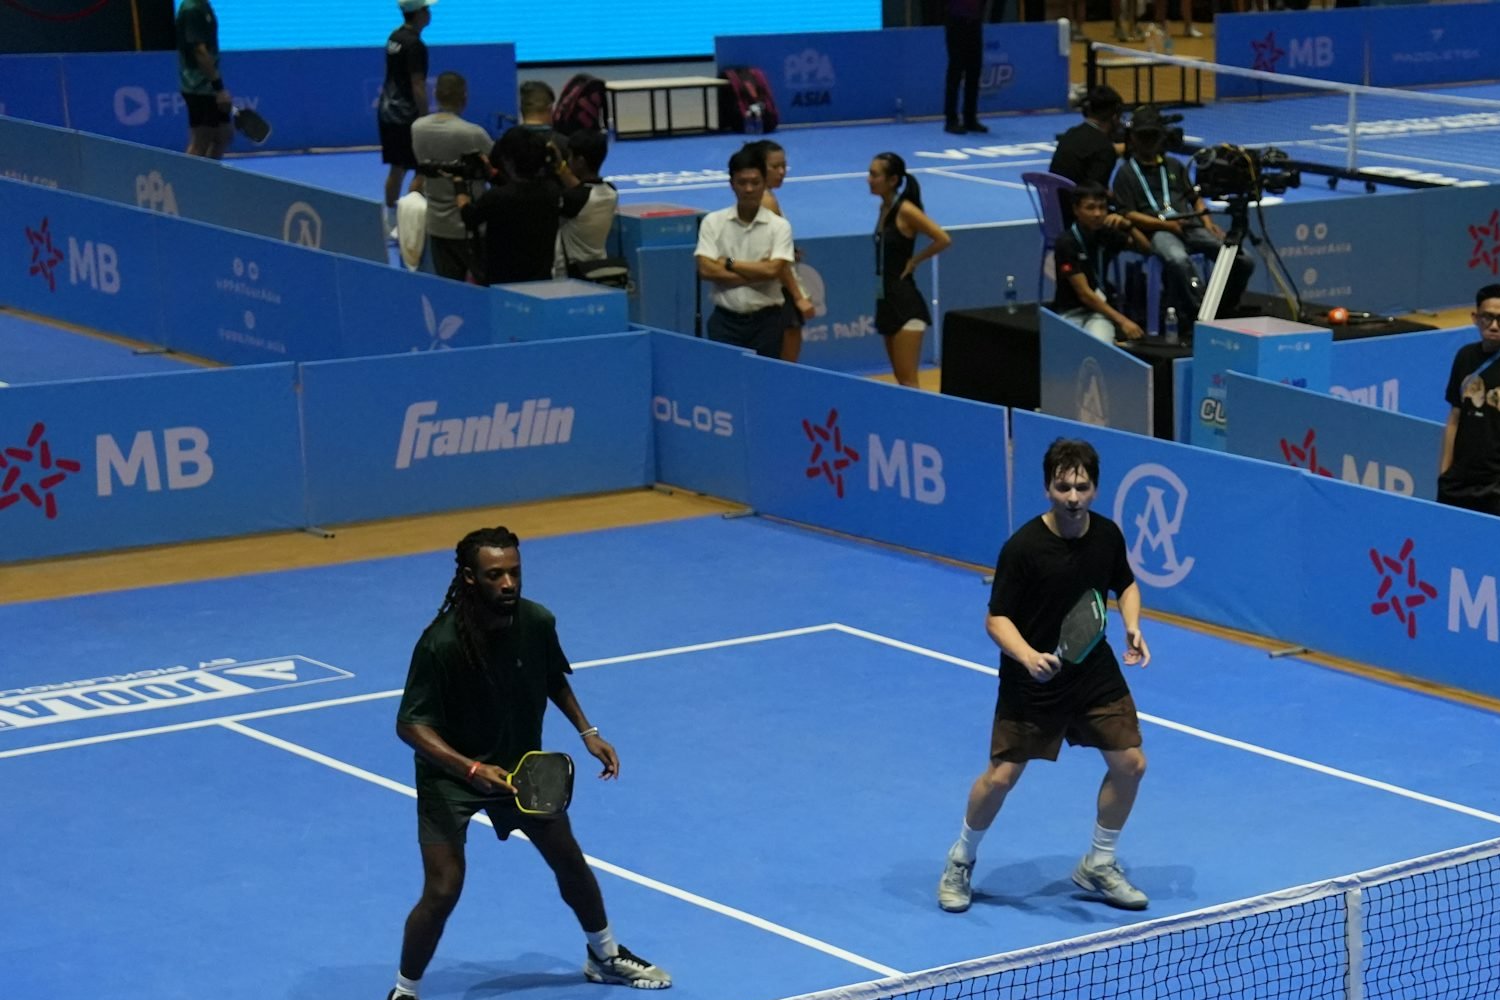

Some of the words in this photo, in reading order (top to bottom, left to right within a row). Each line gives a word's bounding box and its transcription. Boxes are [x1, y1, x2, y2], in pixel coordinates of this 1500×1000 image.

[979, 64, 1015, 88] UP
[1288, 37, 1335, 68] MB
[68, 236, 120, 294] MB
[93, 427, 214, 497] MB
[867, 432, 946, 504] MB
